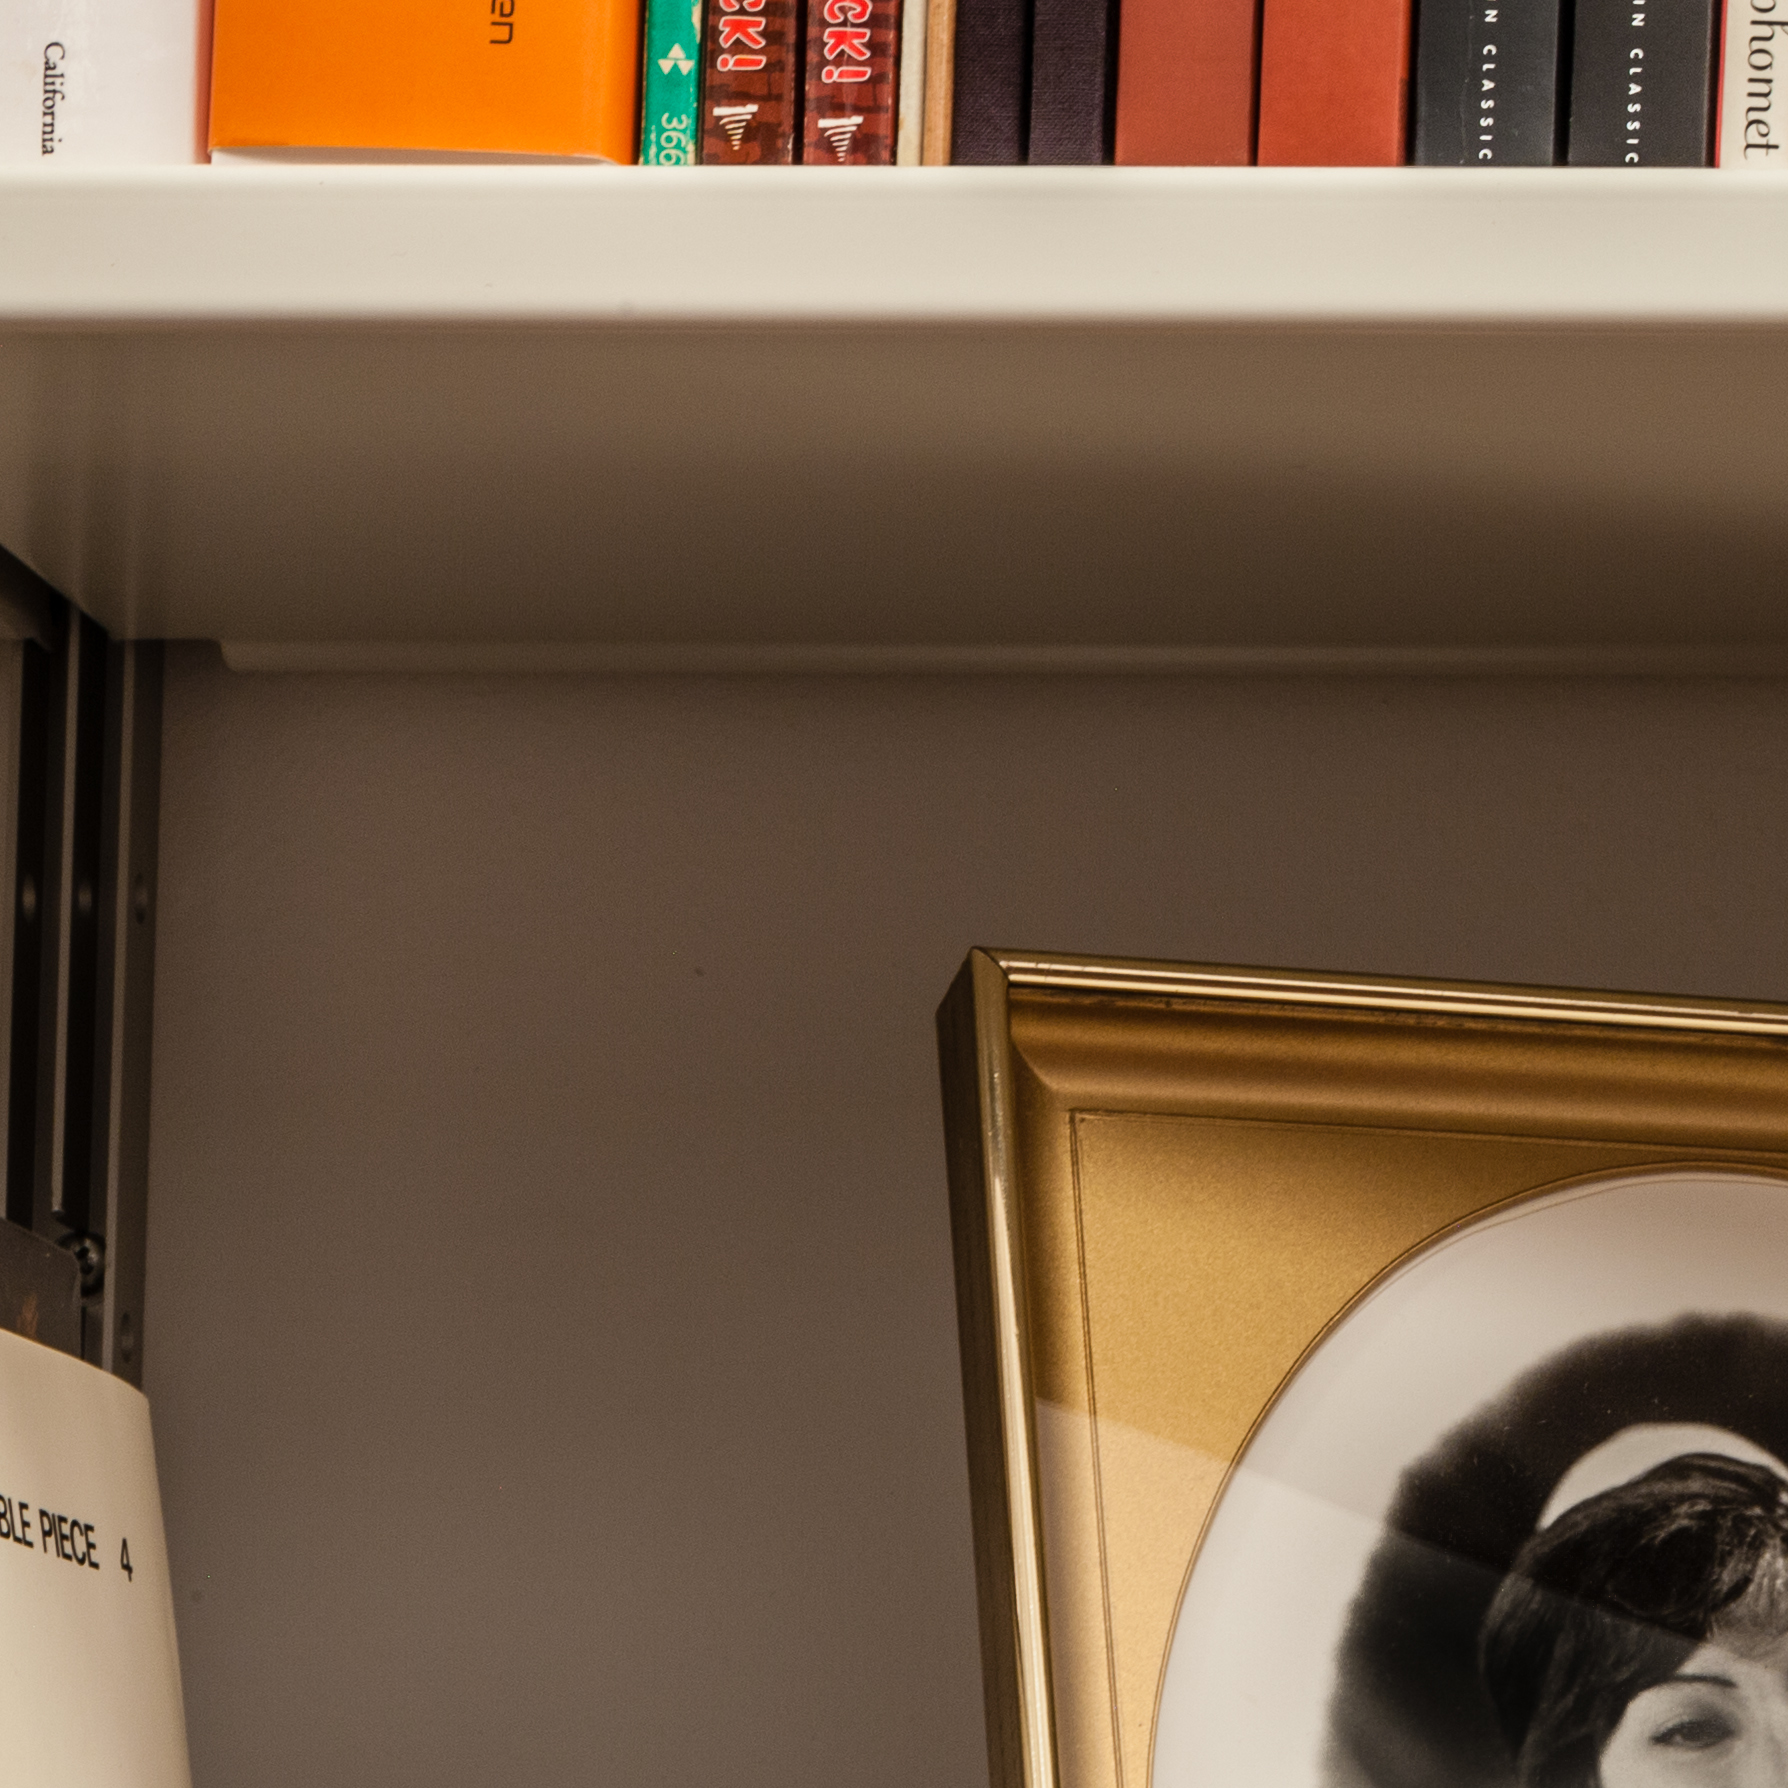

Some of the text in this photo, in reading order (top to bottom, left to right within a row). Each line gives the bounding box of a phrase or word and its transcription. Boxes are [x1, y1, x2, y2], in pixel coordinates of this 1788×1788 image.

[41, 41, 66, 157] California
[1478, 44, 1497, 161] CLASSIC
[1625, 48, 1644, 164] CLASSIC
[0, 1493, 134, 1583] BLE PIECE 4
